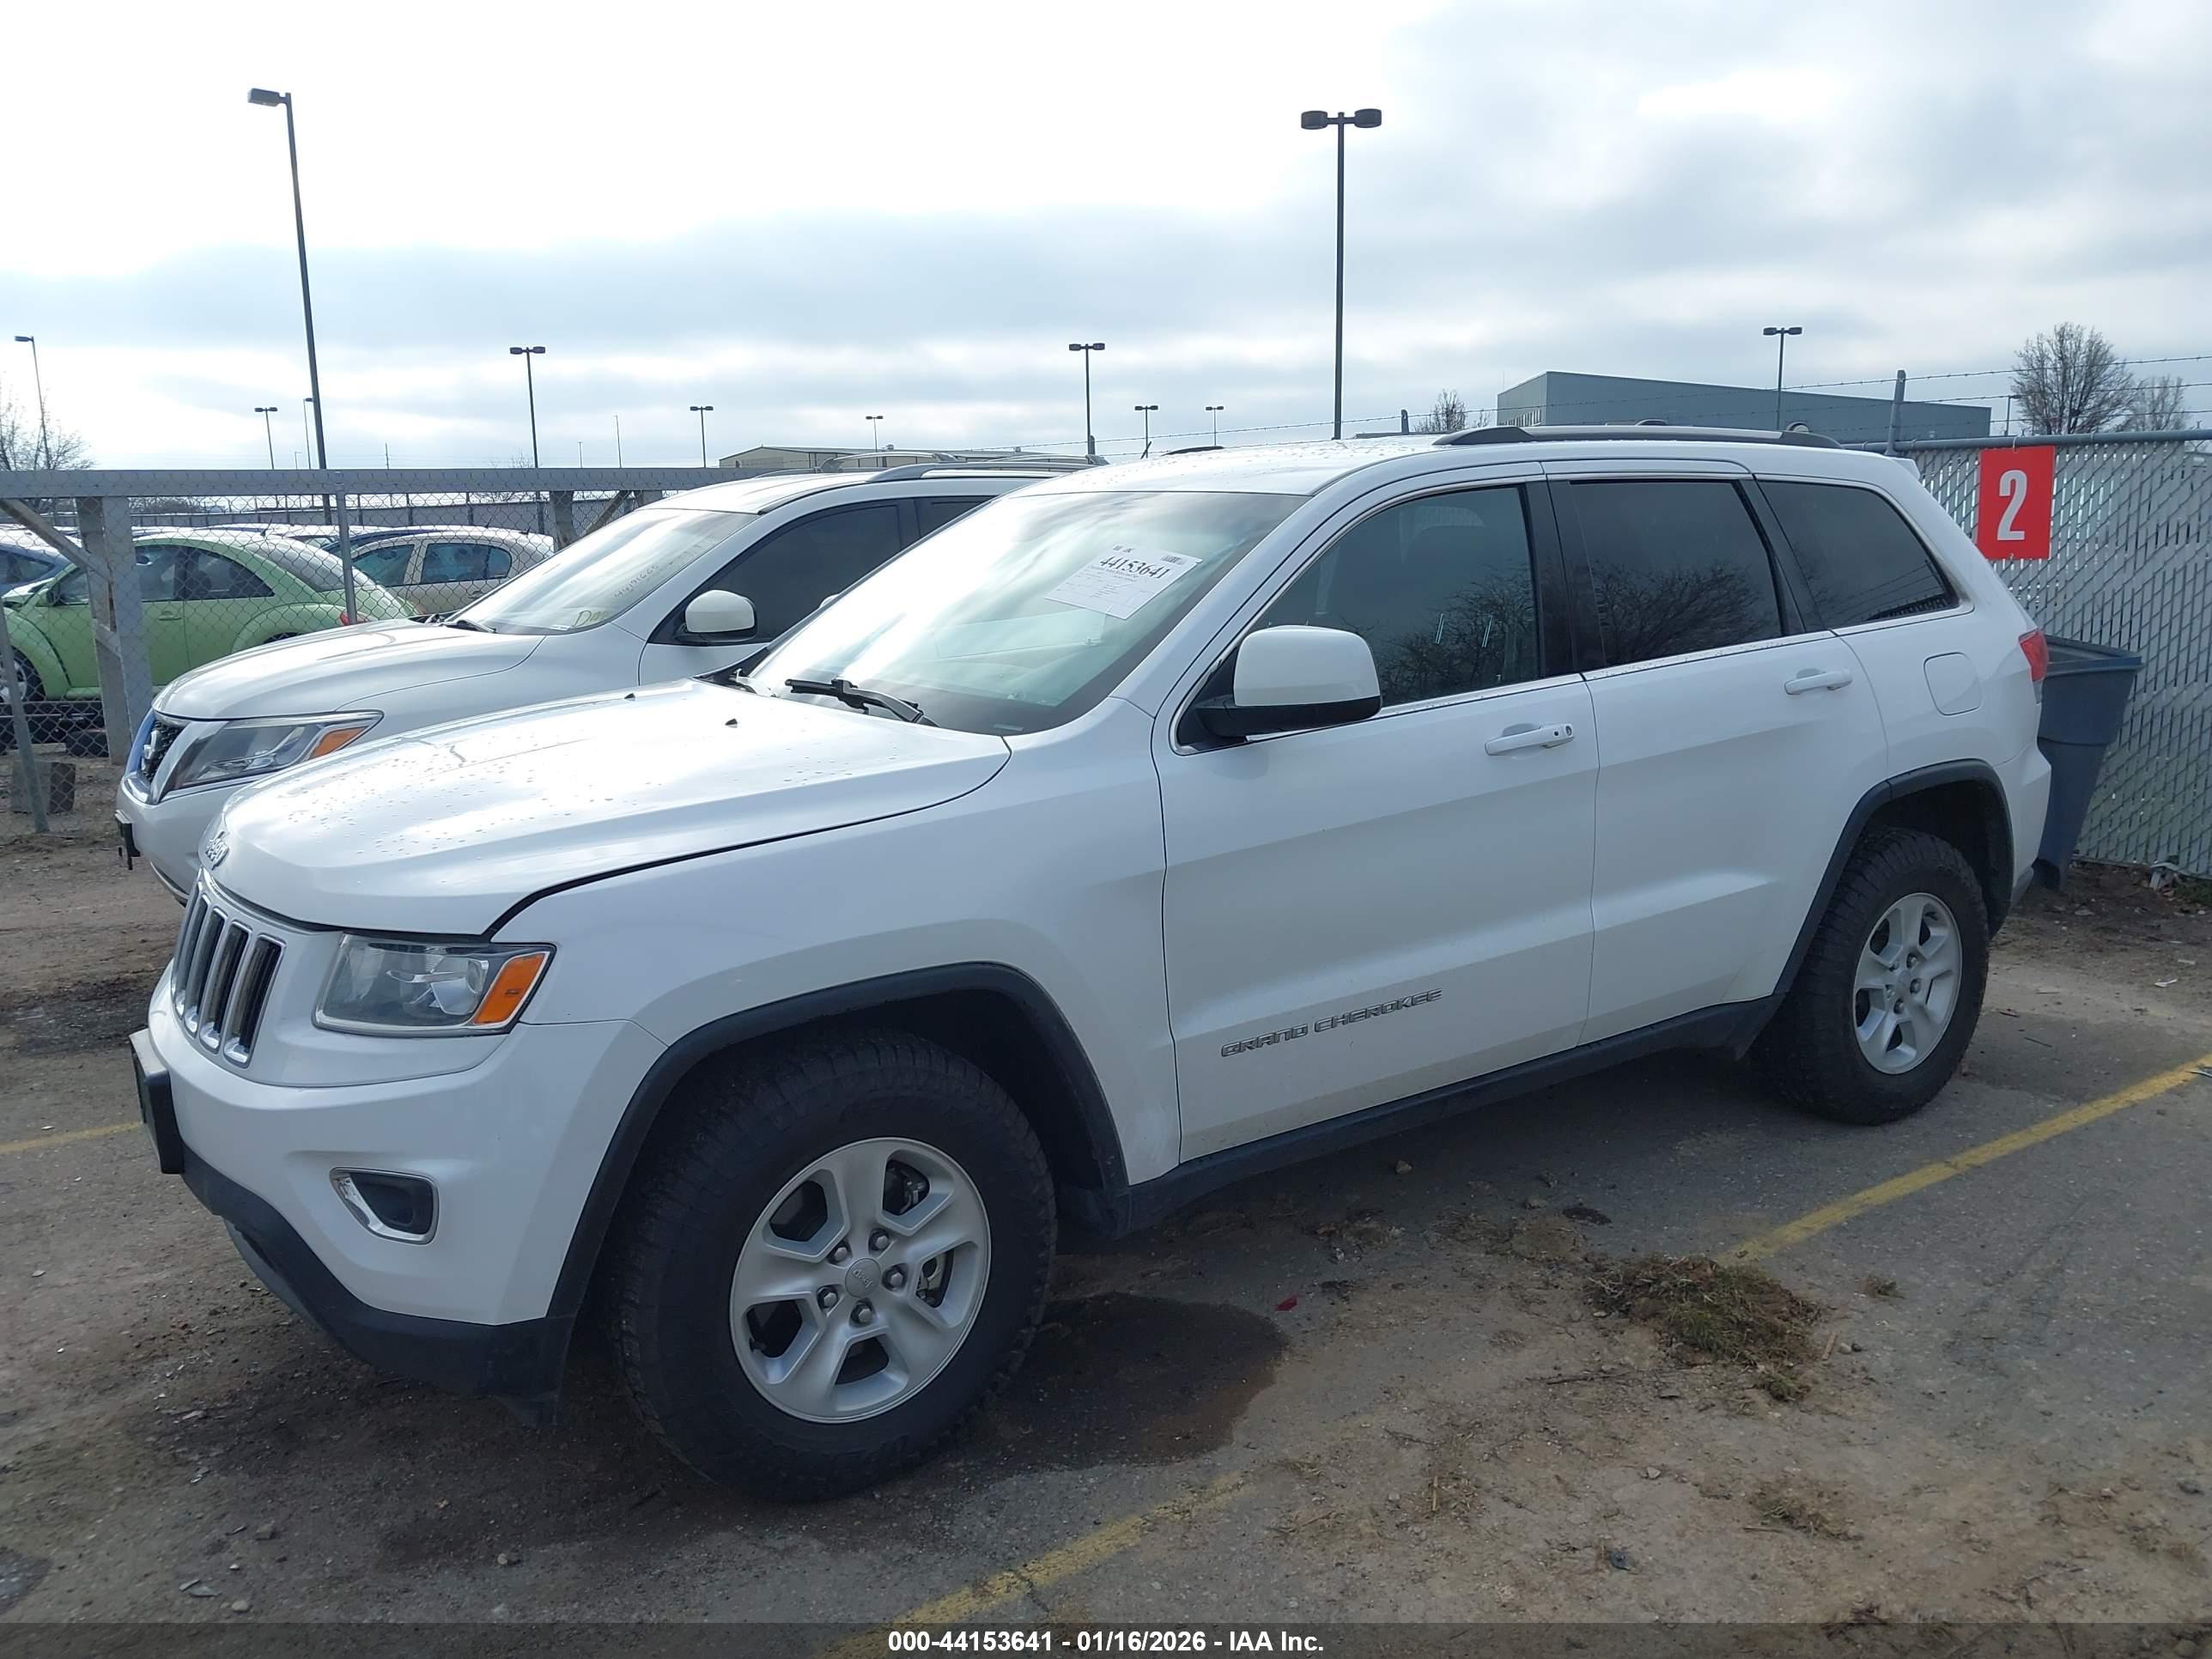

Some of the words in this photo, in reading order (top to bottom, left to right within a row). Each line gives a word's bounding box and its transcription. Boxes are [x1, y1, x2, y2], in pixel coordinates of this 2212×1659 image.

[1997, 470, 2027, 540] 2
[1099, 556, 1170, 579] 44153641
[1221, 1024, 1308, 1057] GRAND
[1314, 988, 1443, 1033] CHEROKEE
